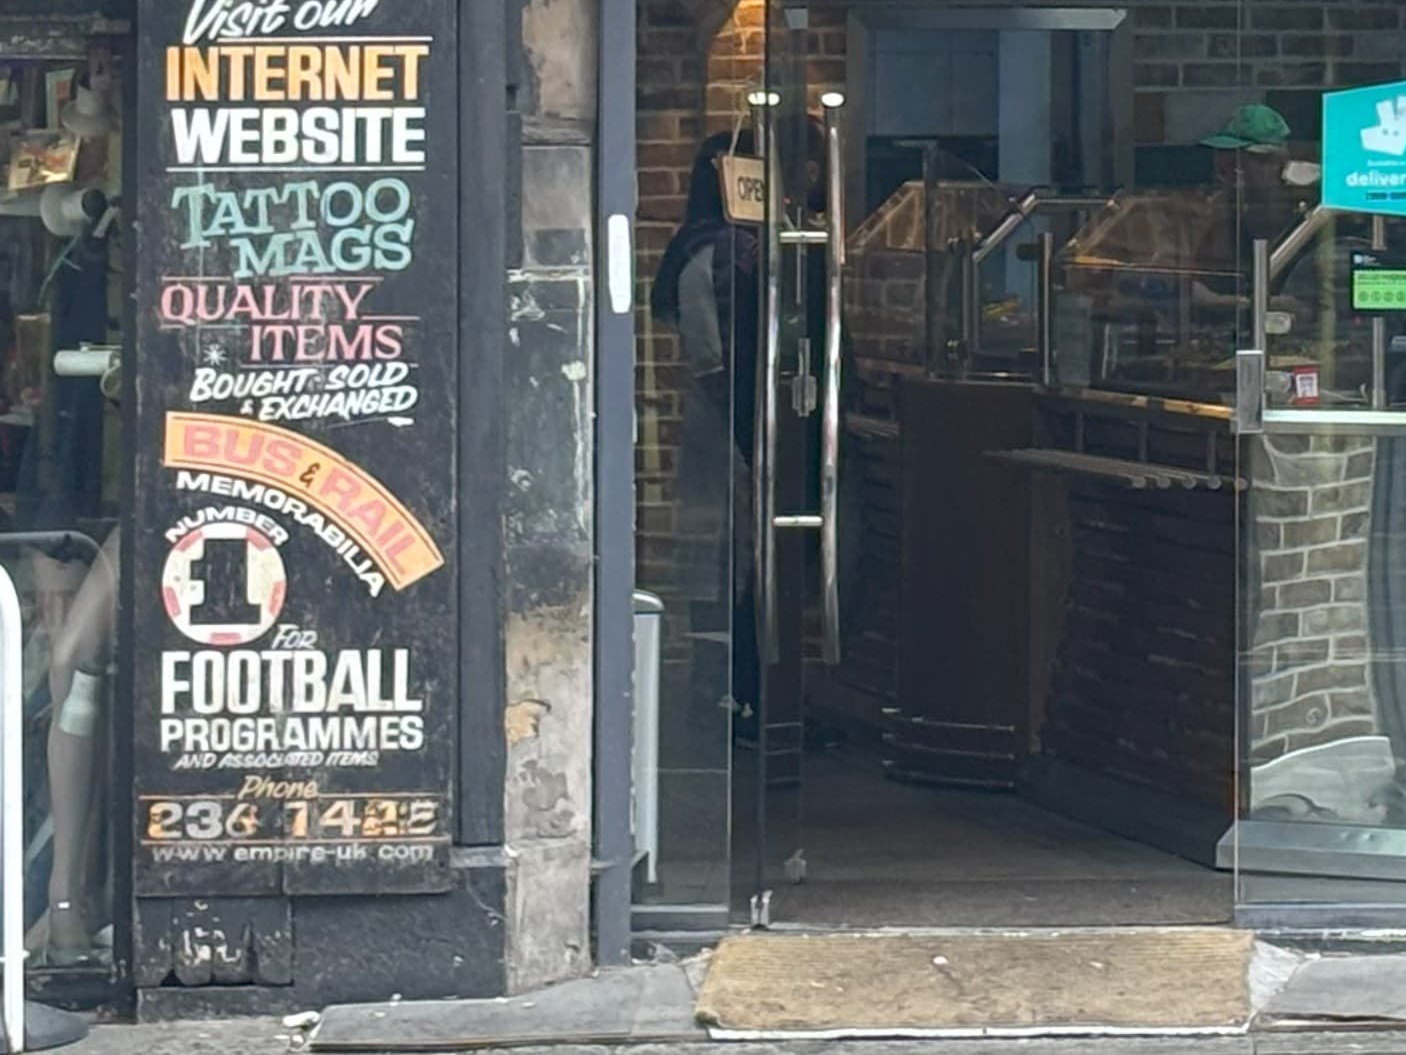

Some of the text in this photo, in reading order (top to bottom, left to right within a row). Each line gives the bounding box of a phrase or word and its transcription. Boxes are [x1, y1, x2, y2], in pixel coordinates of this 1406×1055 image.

[165, 46, 429, 101] INTERNET
[171, 108, 426, 164] WEBSITE
[171, 178, 411, 250] TATTOO
[230, 219, 415, 278] MAGS
[160, 283, 373, 325] QUALITY
[250, 325, 403, 361] ITEMS
[189, 362, 410, 402] BOUGHT SOLD
[259, 386, 418, 421] EXCHANGED
[183, 424, 303, 476] BUS
[318, 465, 417, 577] RAIL
[165, 506, 289, 545] NUMBER
[176, 471, 386, 597] MEMORABILIA
[189, 538, 261, 625] 1
[161, 649, 423, 714] FOOTBALL
[161, 715, 424, 751] PROGRAMMES
[174, 751, 379, 769] AND ASSOCIATED ITEMS
[237, 775, 319, 798] Phone
[147, 802, 260, 839] 236
